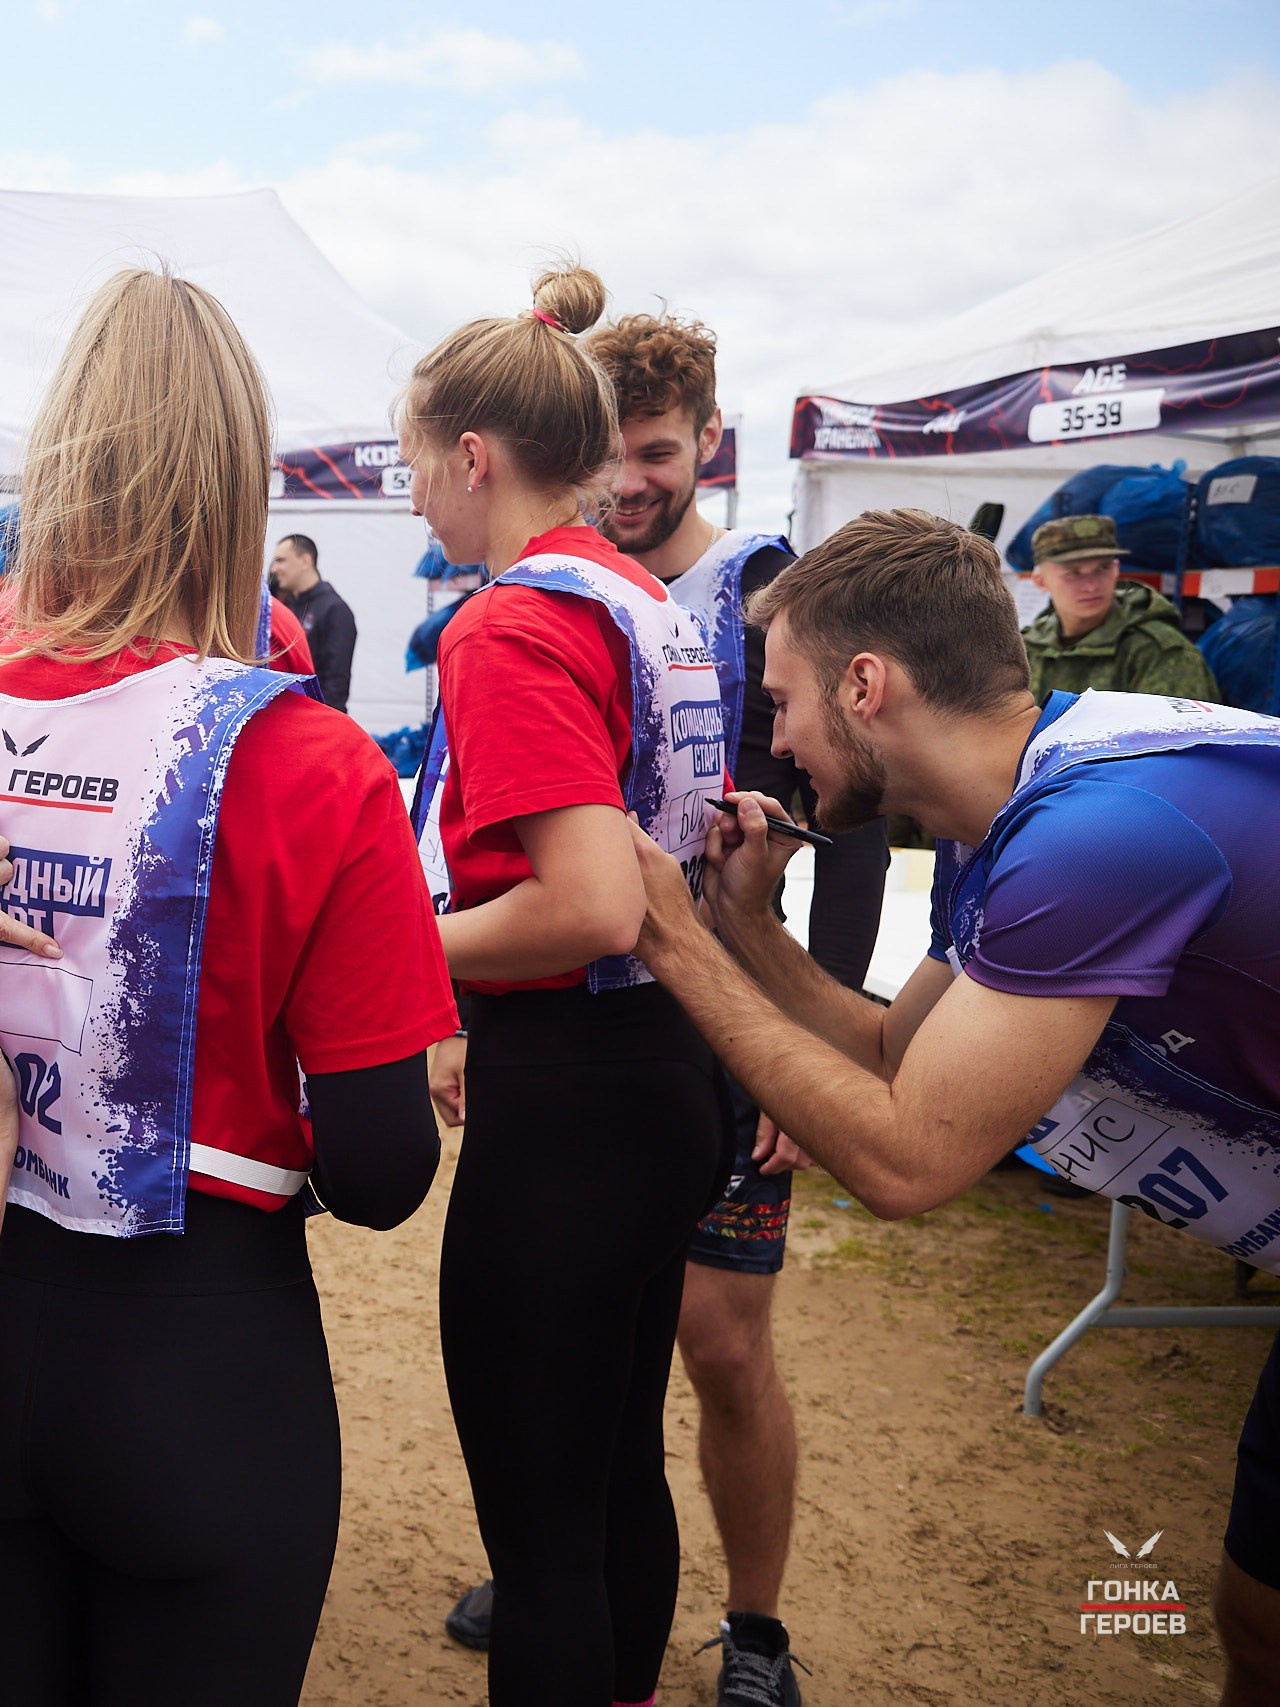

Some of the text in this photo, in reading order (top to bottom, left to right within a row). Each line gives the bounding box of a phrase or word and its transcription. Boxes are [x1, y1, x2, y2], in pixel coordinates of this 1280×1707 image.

[1071, 362, 1127, 395] AGE
[1061, 401, 1122, 432] 35-39
[671, 706, 724, 744] КОМАНДНЫ
[693, 742, 719, 773] СТАРТ
[8, 768, 119, 803] ГЕРОЕВ
